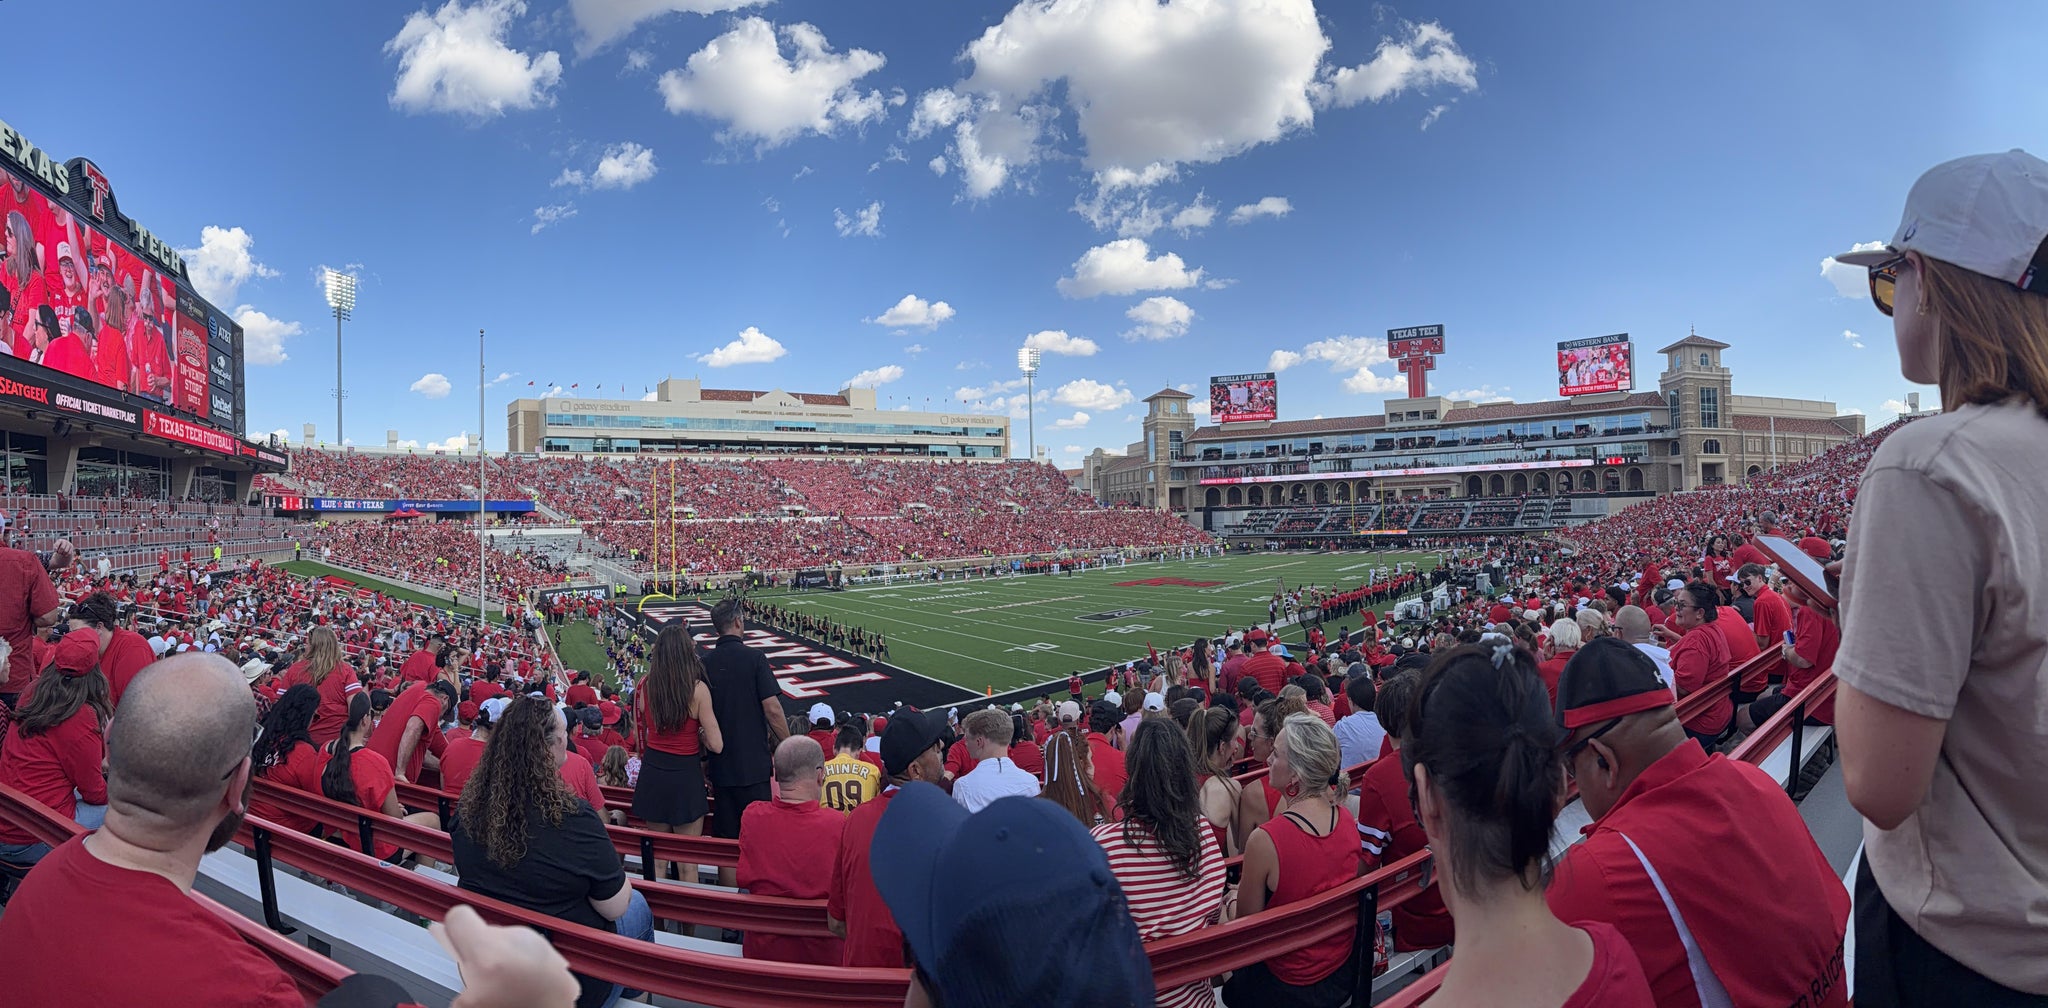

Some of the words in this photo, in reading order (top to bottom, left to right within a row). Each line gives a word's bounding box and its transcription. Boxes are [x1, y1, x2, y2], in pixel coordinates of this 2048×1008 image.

[134, 221, 181, 277] TECH
[218, 326, 231, 344] AT&T
[1392, 328, 1417, 339] TEXAS
[1419, 326, 1438, 336] TECH
[1572, 338, 1602, 347] WESTERN
[1602, 335, 1620, 343] BANK
[180, 363, 206, 385] IN-VENUE
[185, 379, 203, 396] STORE
[0, 376, 48, 405] SEATGEEK
[56, 393, 81, 410] OFFICIAL
[82, 400, 101, 415] TICKET
[101, 405, 136, 424] MARKETPLACE
[212, 394, 231, 415] United
[573, 401, 598, 412] galaxy
[600, 402, 631, 412] stadium
[159, 417, 184, 438] TEXAS
[185, 425, 203, 443] TECH
[203, 431, 233, 451] FOOTBALL
[321, 500, 336, 509] BLUE
[344, 500, 355, 509] SKY
[362, 501, 384, 509] TEXAS
[824, 763, 869, 780] HINER
[826, 780, 862, 811] 09
